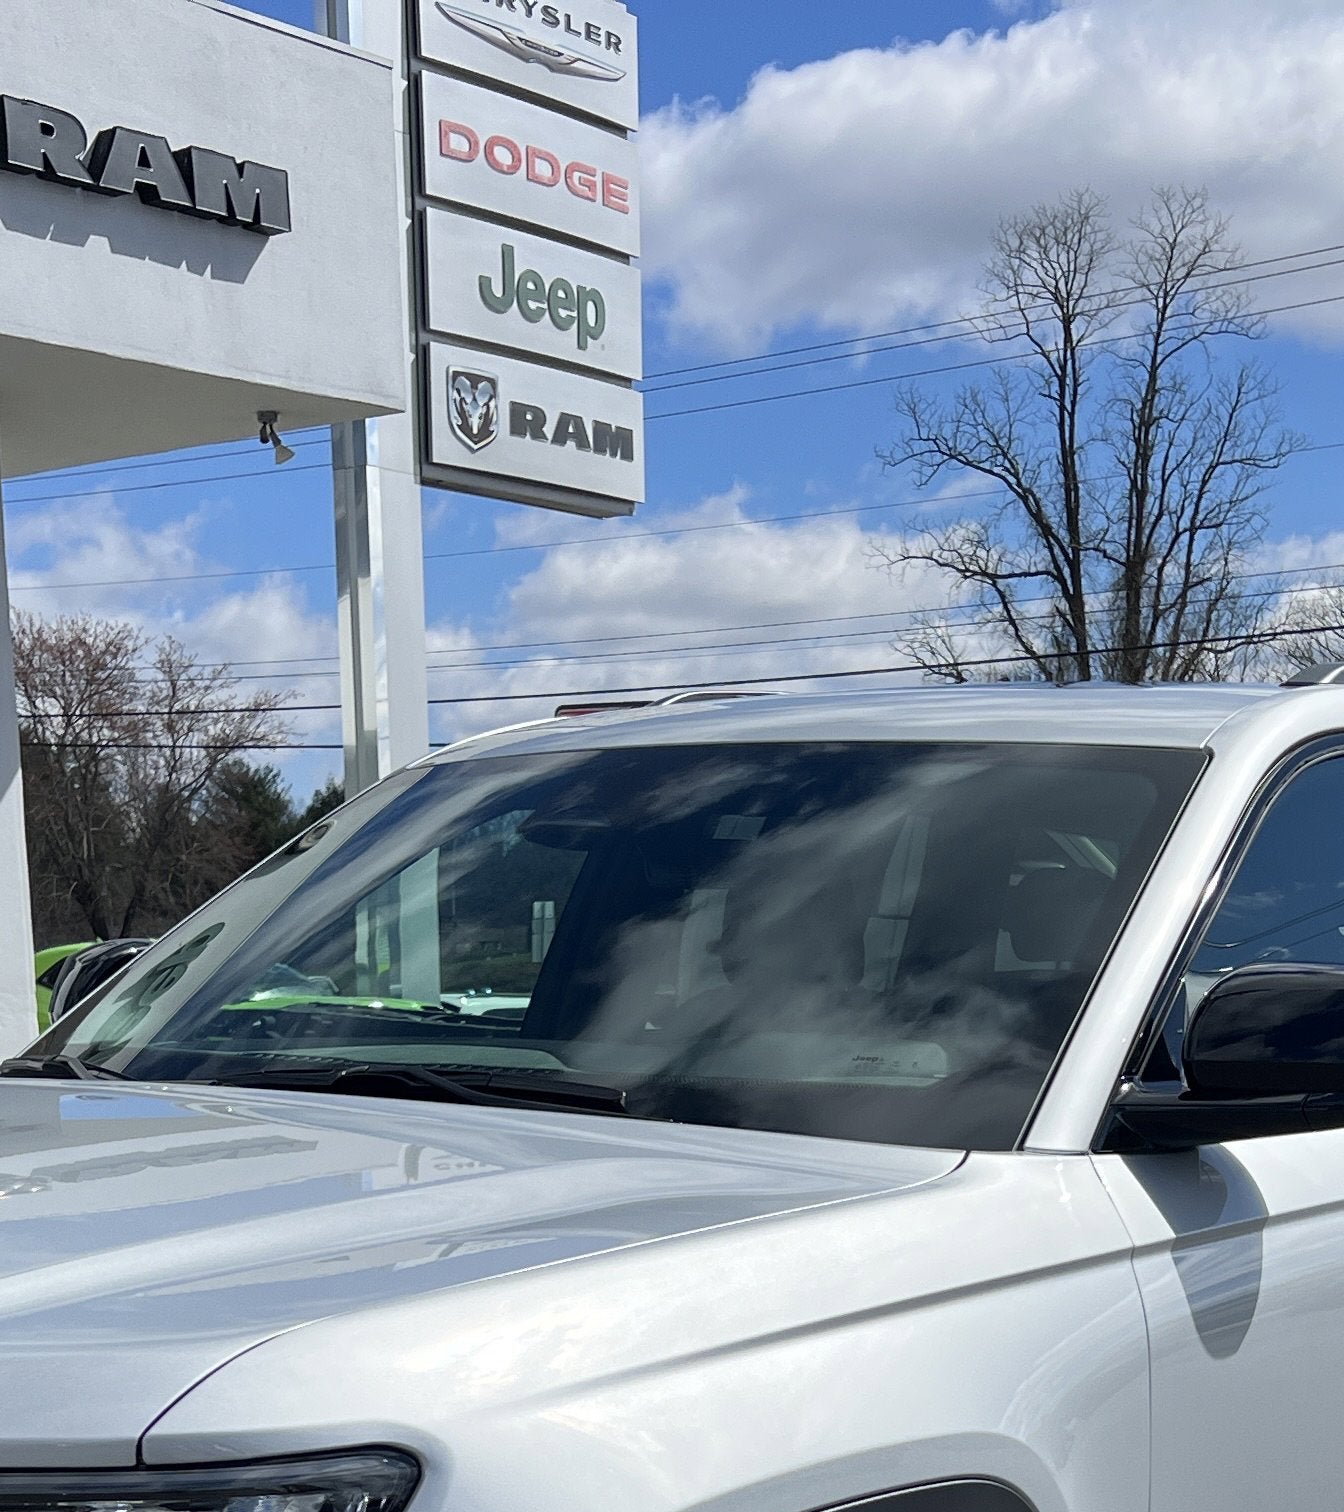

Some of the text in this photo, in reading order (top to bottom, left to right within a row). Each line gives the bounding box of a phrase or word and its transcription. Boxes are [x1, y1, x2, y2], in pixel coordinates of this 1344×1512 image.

[439, 119, 630, 215] DODGE
[478, 243, 606, 351] Jeep
[509, 400, 634, 463] RAM
